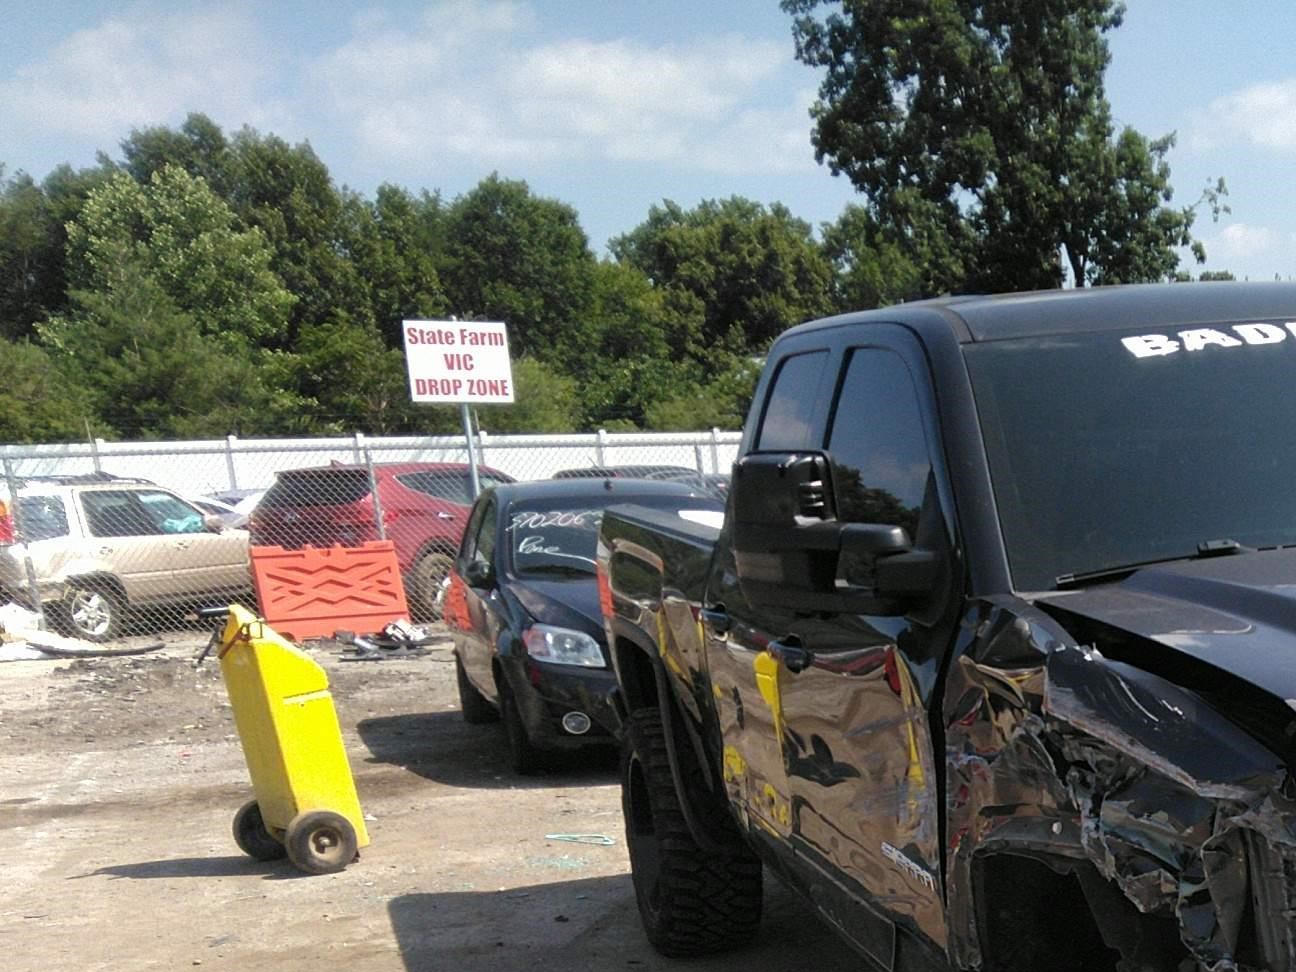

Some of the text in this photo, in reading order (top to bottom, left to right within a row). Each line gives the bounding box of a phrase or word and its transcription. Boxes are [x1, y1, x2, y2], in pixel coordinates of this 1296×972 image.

[407, 327, 505, 347] State Farm
[443, 353, 475, 371] VIC
[415, 379, 510, 397] DROP ZONE
